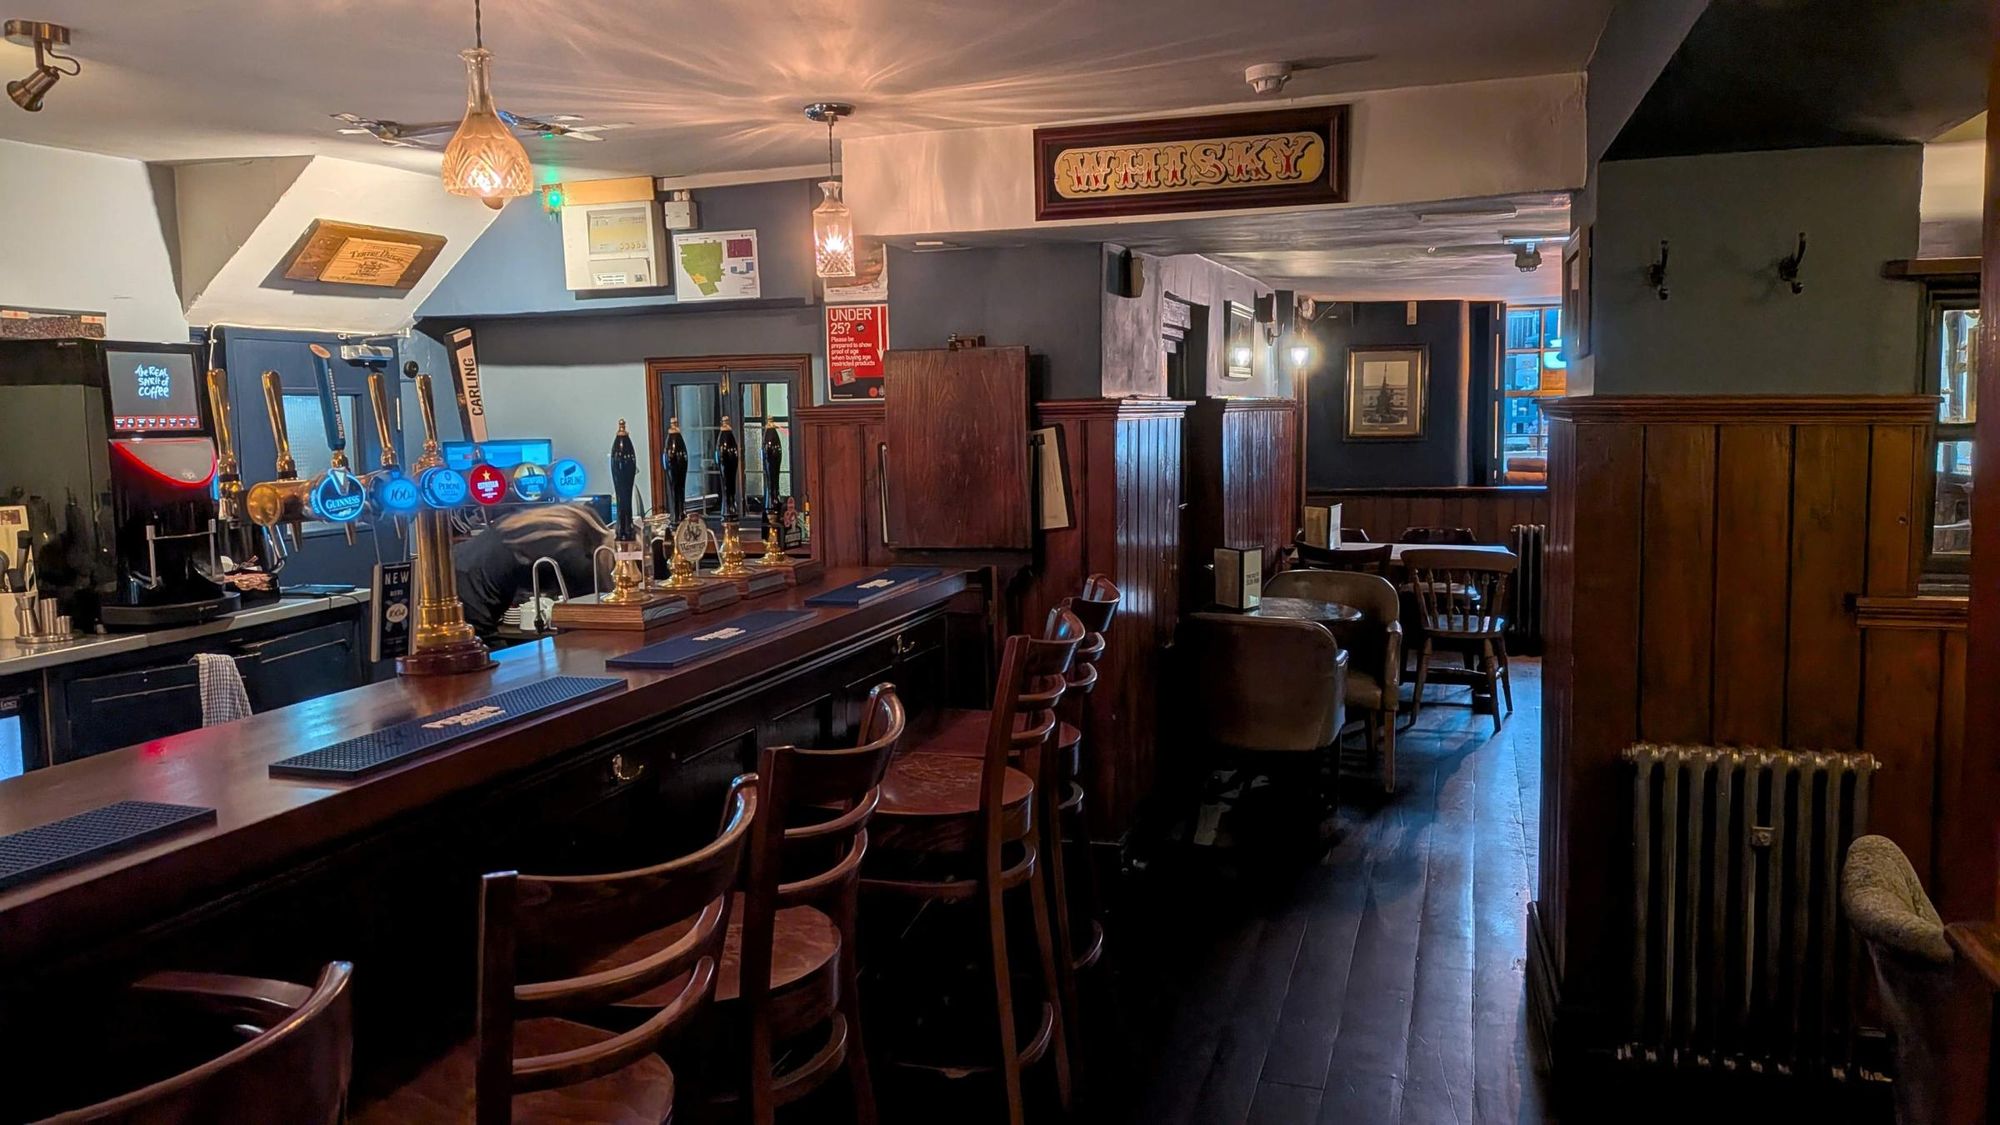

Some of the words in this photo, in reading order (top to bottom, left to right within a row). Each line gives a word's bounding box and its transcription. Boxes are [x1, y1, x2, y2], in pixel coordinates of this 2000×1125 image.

[1064, 136, 1315, 192] WHISKY
[830, 308, 872, 321] UNDER
[830, 322, 851, 335] 25?
[148, 366, 168, 378] REAL
[161, 376, 169, 386] of
[463, 358, 484, 416] CARLING
[325, 495, 360, 509] GUINNESS
[384, 571, 409, 585] NEW
